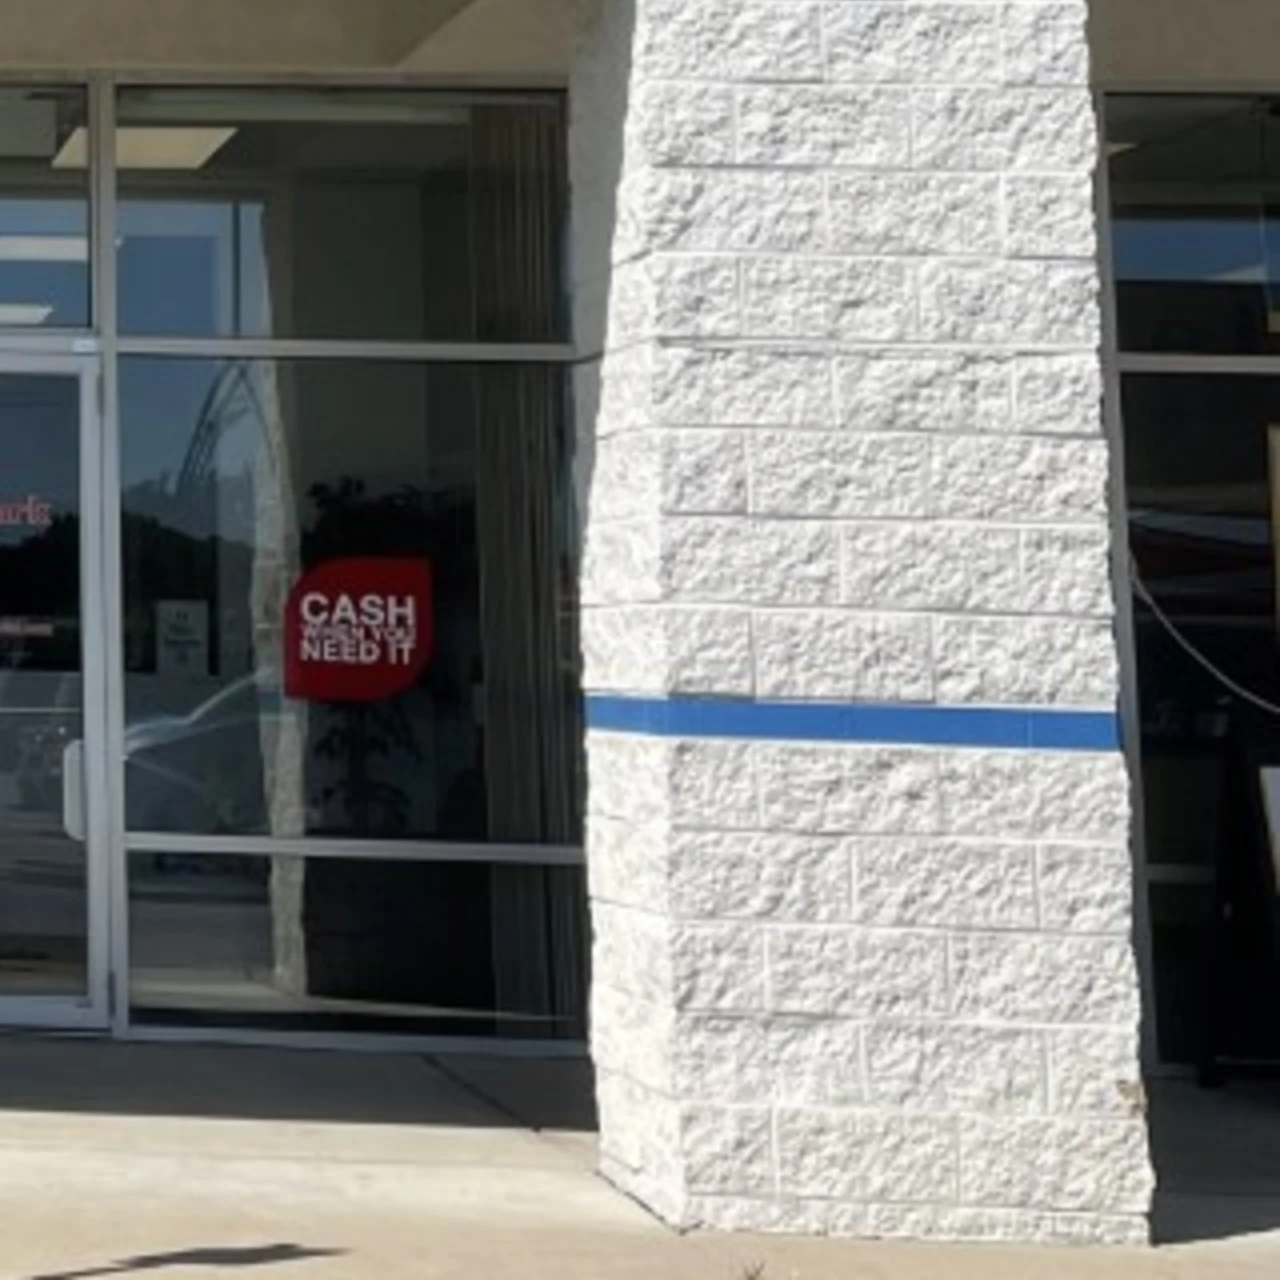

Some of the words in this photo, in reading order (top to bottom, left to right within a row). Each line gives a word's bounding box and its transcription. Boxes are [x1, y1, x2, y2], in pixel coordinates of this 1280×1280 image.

[300, 592, 416, 626] CASH
[300, 639, 381, 664] NEED
[390, 642, 417, 665] IT
